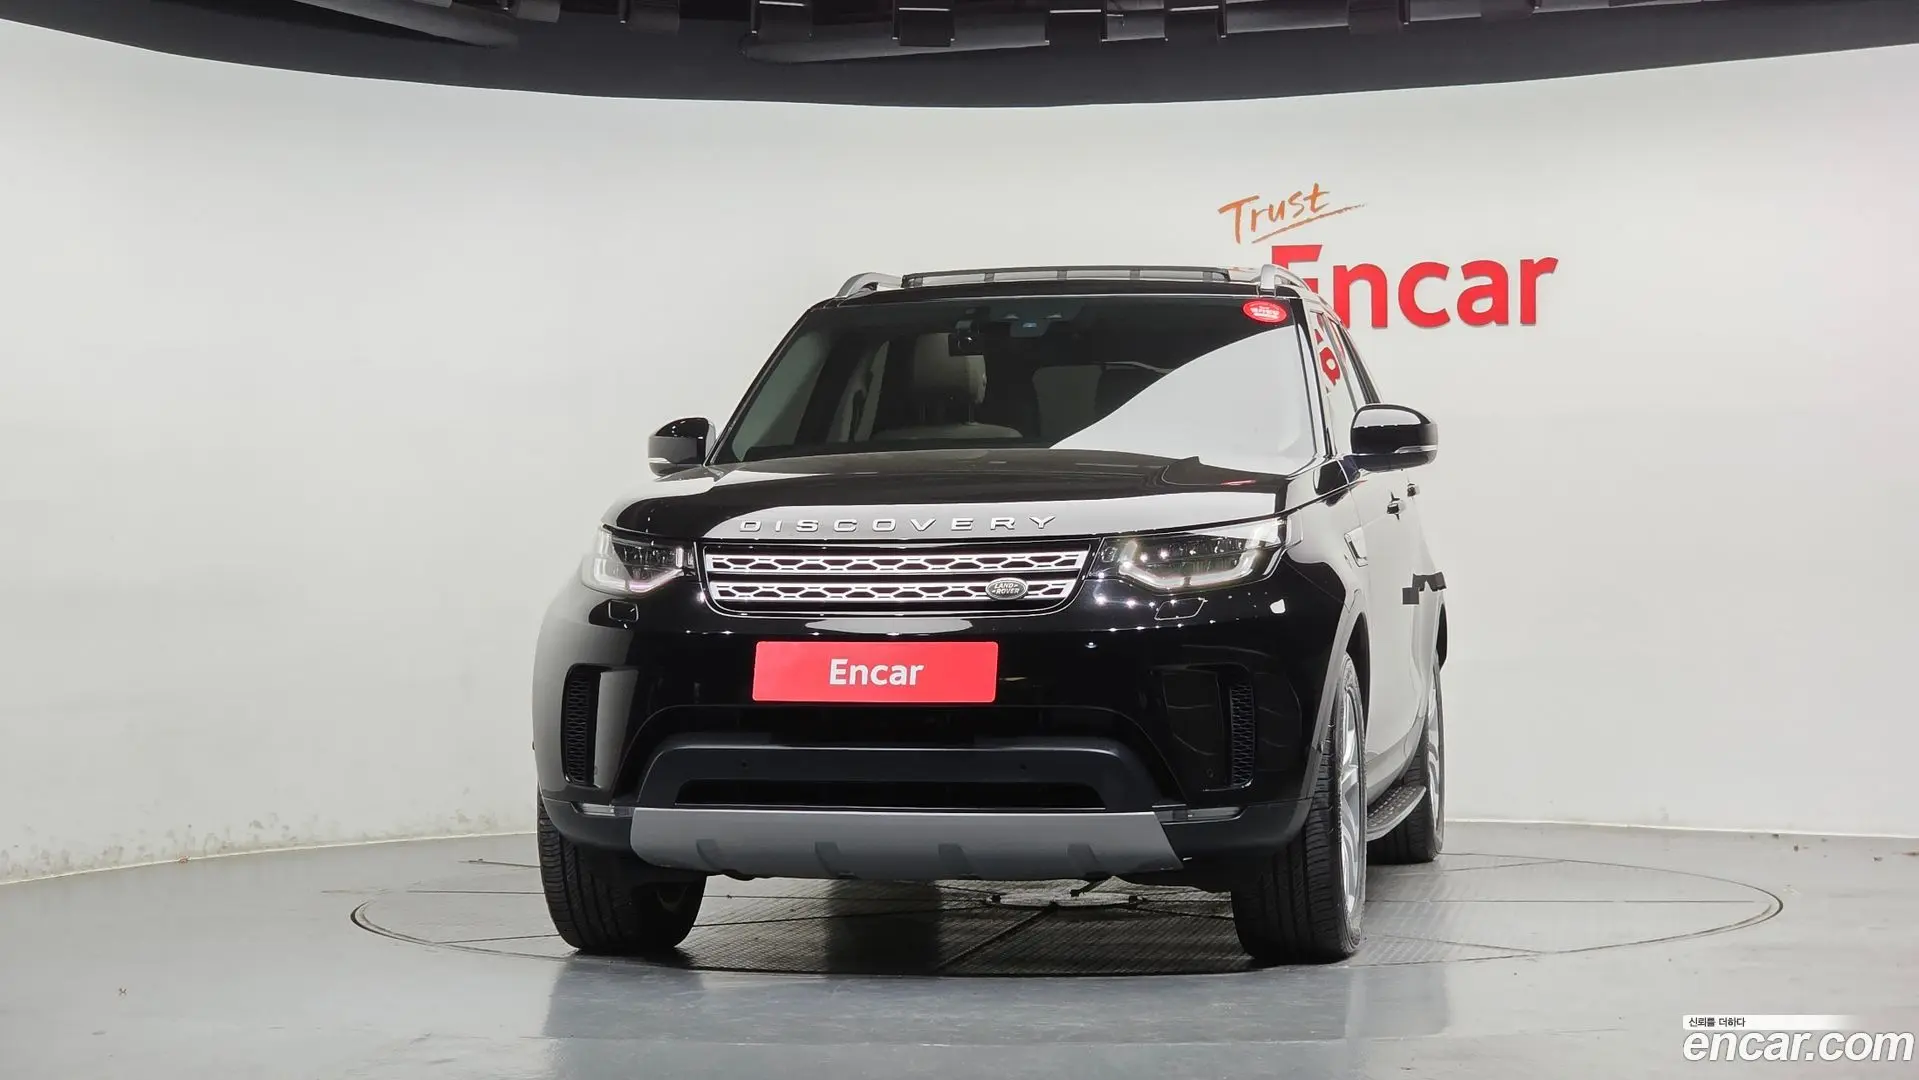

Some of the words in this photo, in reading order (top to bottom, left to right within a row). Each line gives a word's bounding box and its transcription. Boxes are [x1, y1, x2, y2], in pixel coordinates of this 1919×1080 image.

[1218, 183, 1330, 244] Trust
[739, 516, 1056, 533] DISCOVERY
[828, 658, 925, 686] Encar
